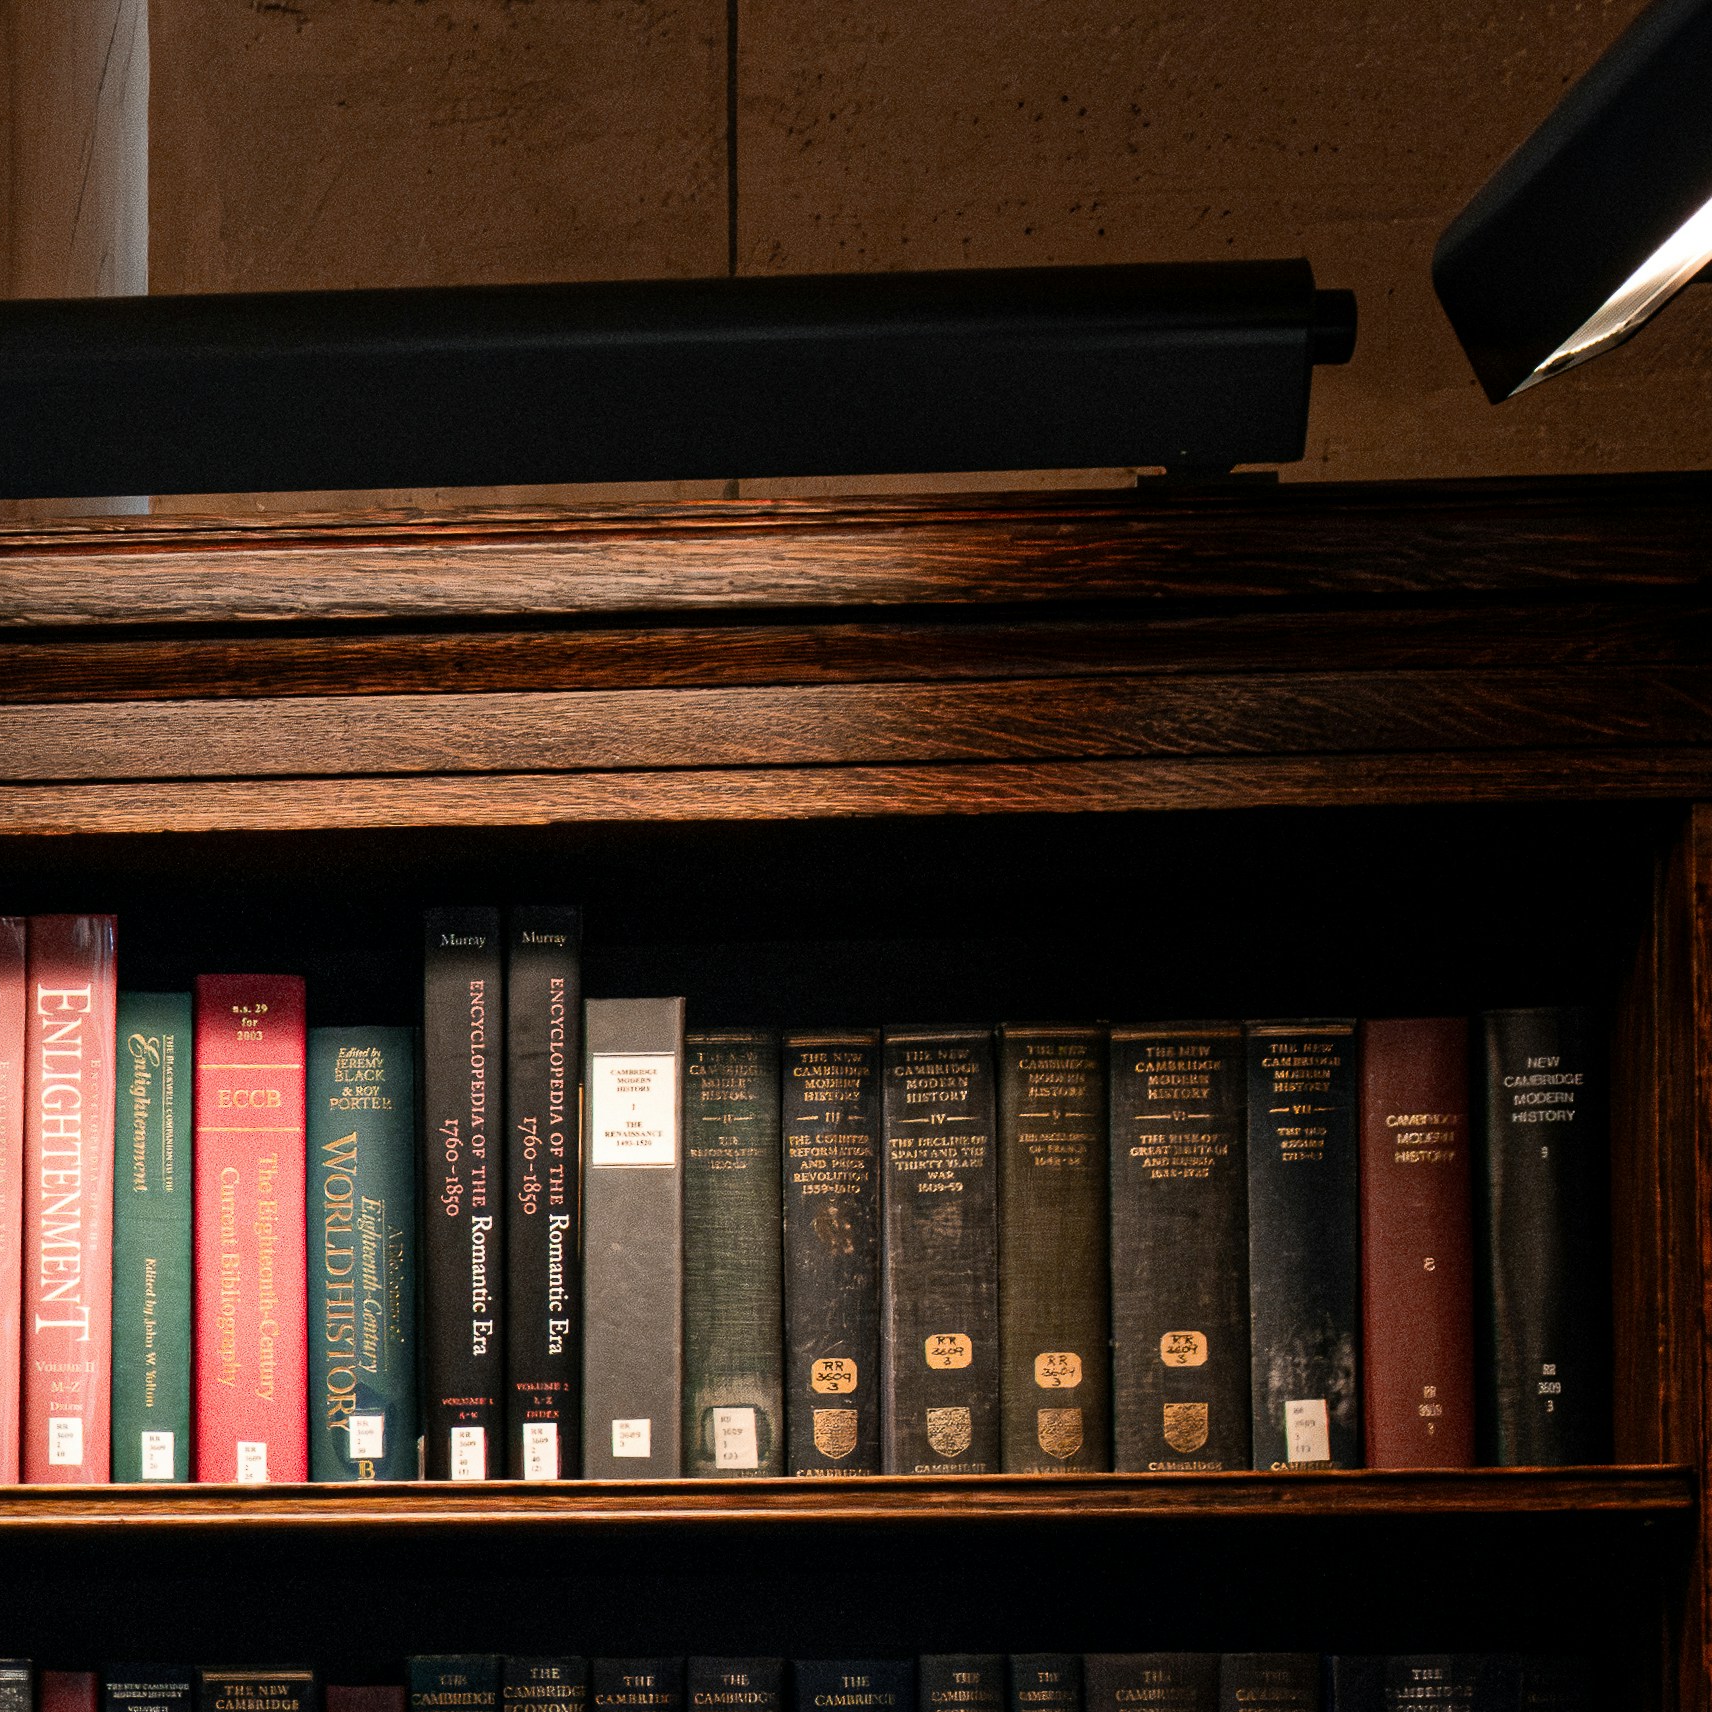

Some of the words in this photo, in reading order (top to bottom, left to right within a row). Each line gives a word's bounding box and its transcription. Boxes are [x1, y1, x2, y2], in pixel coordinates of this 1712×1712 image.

[440, 933, 486, 948] Murray
[522, 930, 567, 945] Murray
[336, 1058, 384, 1070] JEREMY
[469, 979, 486, 1126] ENCYCLOPEDIA
[549, 977, 564, 1125] ENCYCLOPEDIA
[1528, 1056, 1560, 1069] NEW
[335, 1069, 386, 1083] BLACK
[356, 1086, 380, 1096] ROY
[1504, 1072, 1584, 1087] CAMBRIDGE
[127, 1032, 161, 1192] Enlightenment
[217, 1089, 281, 1109] ECCB
[329, 1097, 393, 1111] PORTER
[1514, 1091, 1574, 1105] MODERN
[1512, 1110, 1576, 1124] HISTORY
[34, 983, 92, 1343] ENLIGHTENMENT
[471, 1134, 486, 1159] OF
[549, 1132, 564, 1158] OF
[258, 1153, 278, 1194] The
[439, 1118, 464, 1217] 1760-1850
[517, 1116, 543, 1215] 1760-1850
[471, 1165, 486, 1208] THE
[549, 1164, 564, 1206] THE
[219, 1166, 240, 1248] Current
[322, 1131, 358, 1277] WORLD
[471, 1215, 493, 1313] Romantic
[548, 1213, 570, 1312] Romantic
[215, 1253, 241, 1388] Bibliography
[472, 1319, 494, 1356] Era
[548, 1318, 570, 1356] Era
[35, 1360, 81, 1374] VOLUME
[325, 1280, 358, 1432] HISTORY
[216, 1699, 299, 1711] CAMBRIDGE
